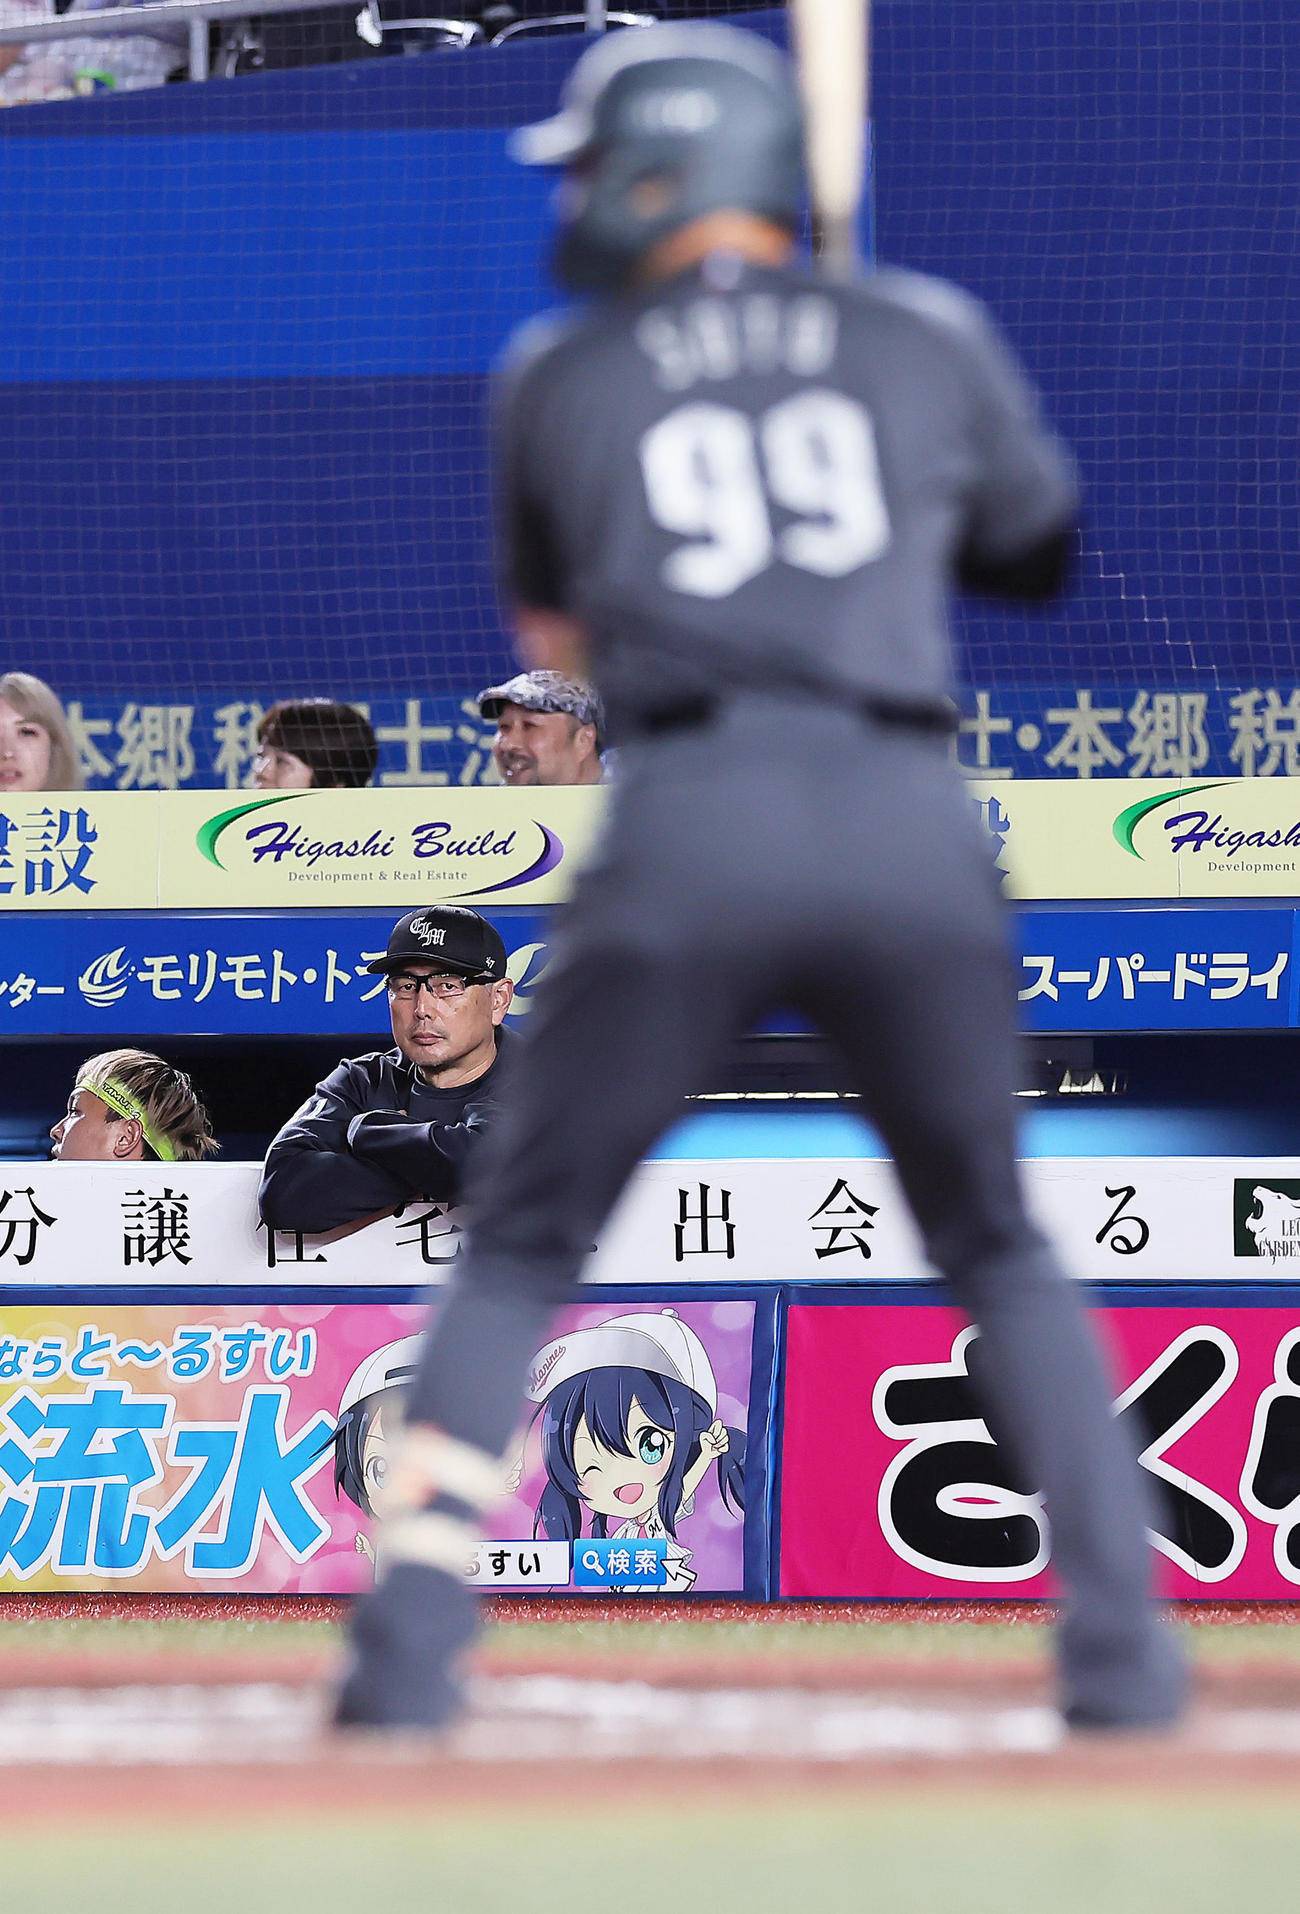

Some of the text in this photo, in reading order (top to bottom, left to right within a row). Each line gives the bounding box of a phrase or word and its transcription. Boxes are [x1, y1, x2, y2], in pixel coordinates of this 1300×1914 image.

[639, 387, 893, 599] 99
[0, 806, 98, 896] 設
[245, 822, 516, 867] Higashi Build
[1207, 860, 1297, 873] Development
[288, 869, 468, 883] Development & Real Estate
[101, 1082, 141, 1119] TAMURA
[528, 1344, 567, 1393] Marines
[0, 1389, 334, 1570] 流水
[606, 1548, 659, 1576] 検索
